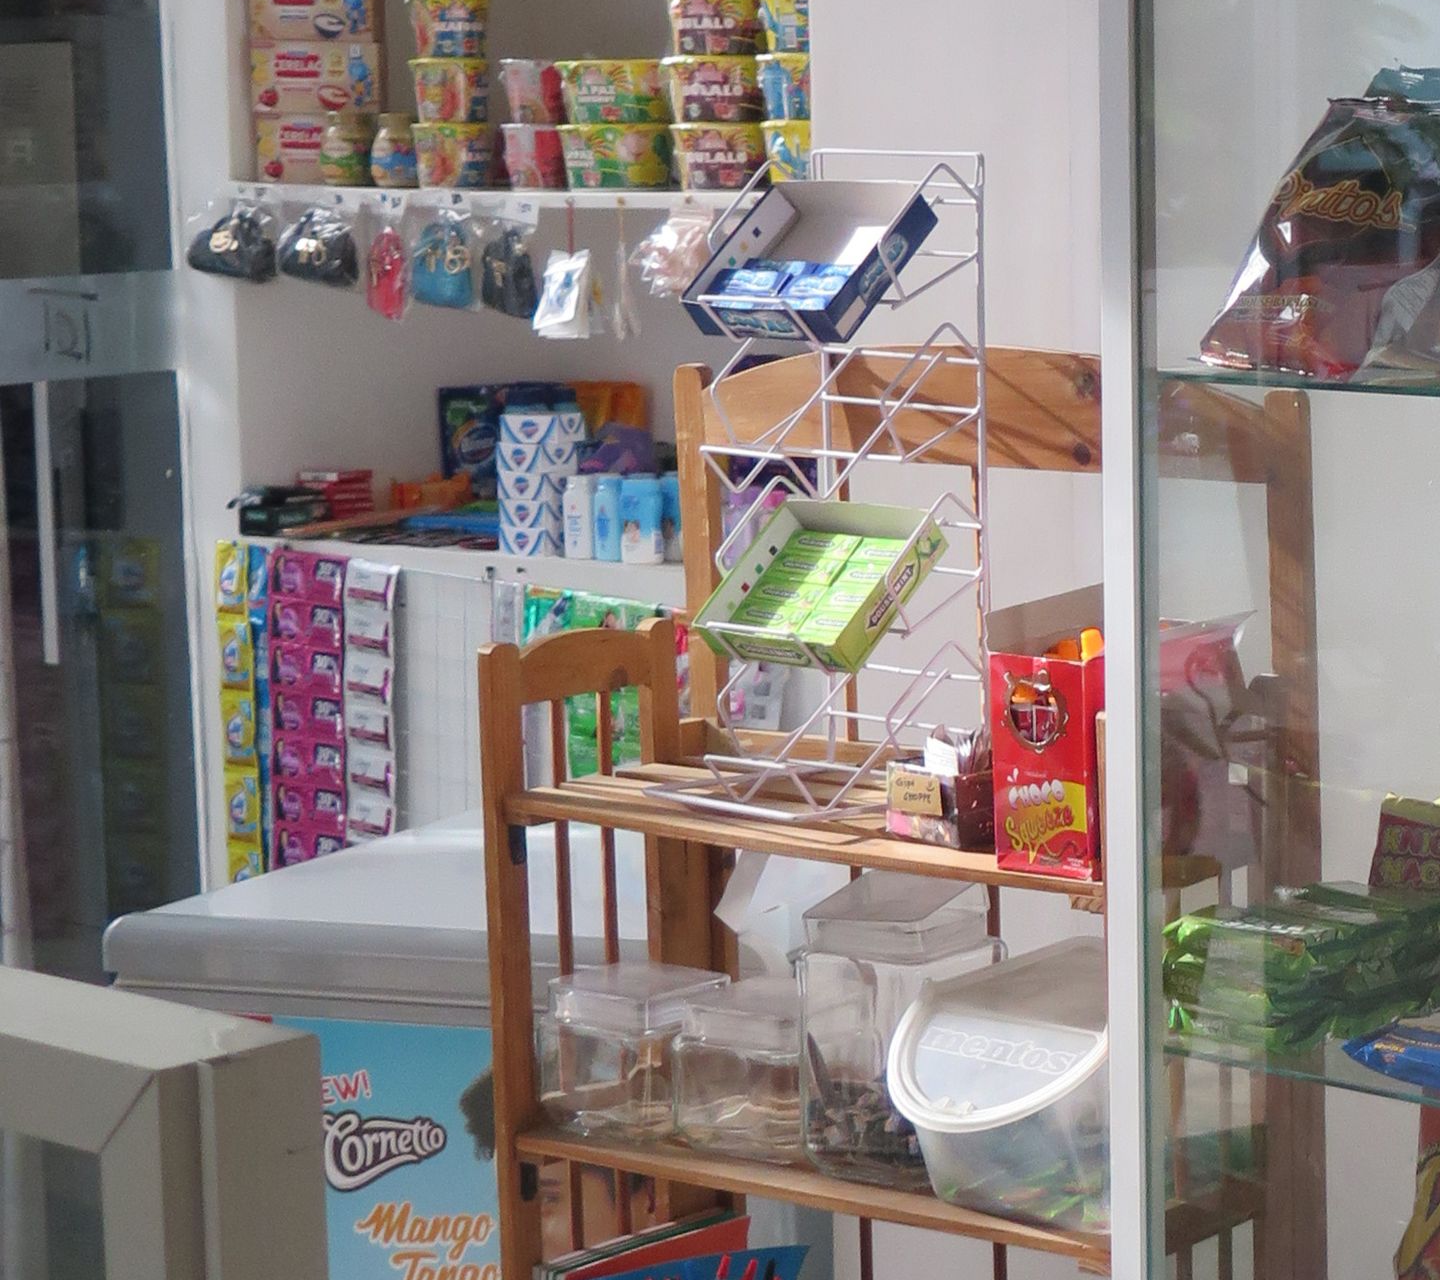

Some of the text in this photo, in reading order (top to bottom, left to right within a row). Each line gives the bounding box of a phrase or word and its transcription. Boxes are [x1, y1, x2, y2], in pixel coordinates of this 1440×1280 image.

[870, 567, 912, 623] DOUBLMINT
[920, 1026, 1077, 1076] mentos
[321, 1111, 446, 1190] Cornetto
[356, 1201, 494, 1261] Mango
